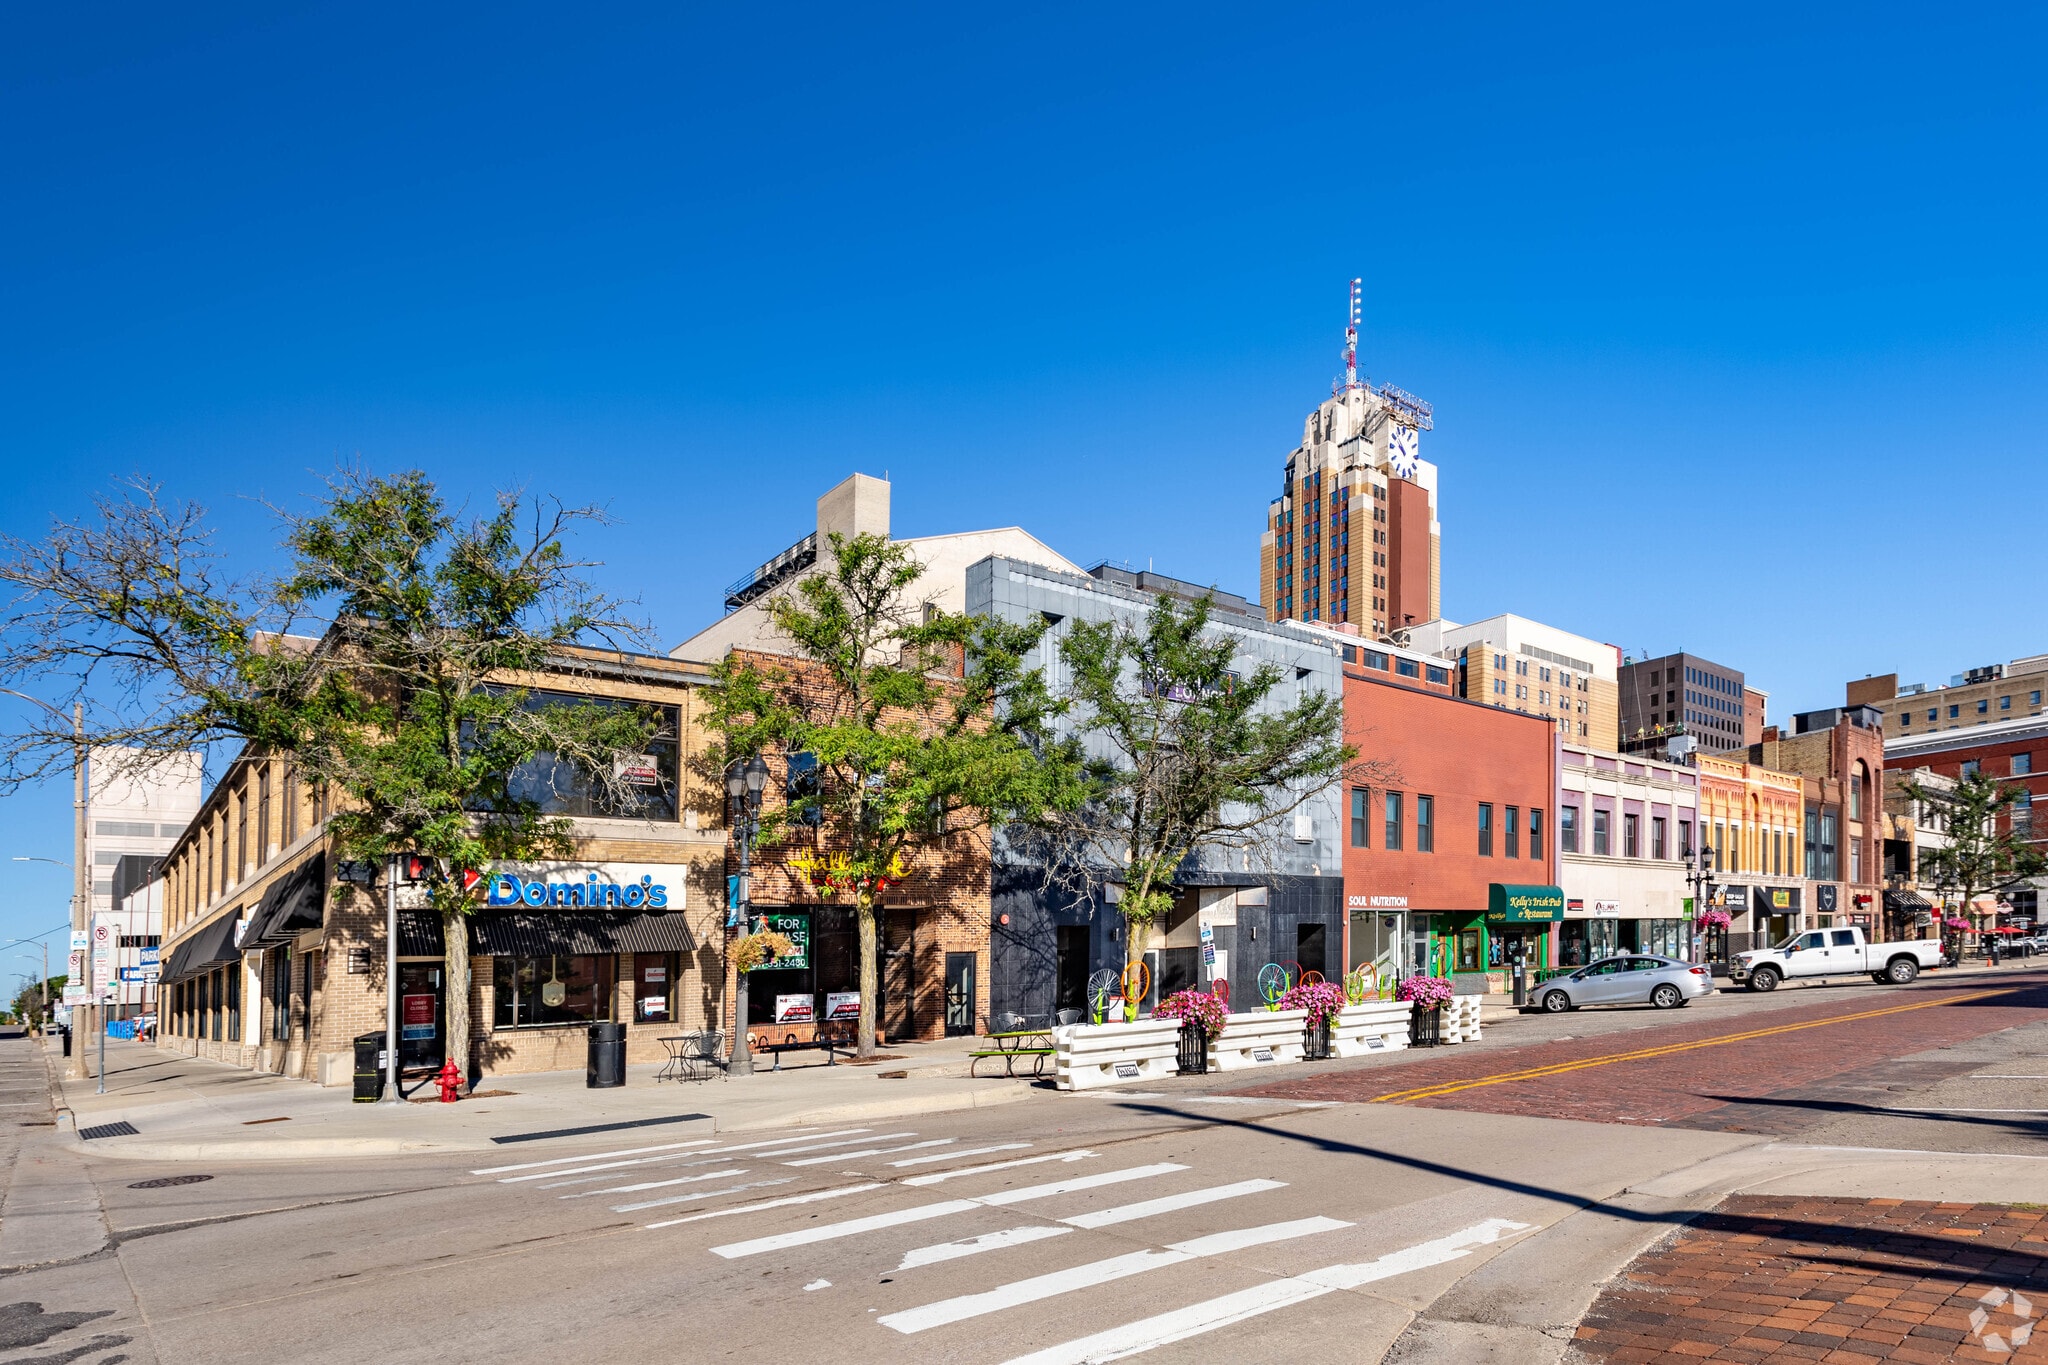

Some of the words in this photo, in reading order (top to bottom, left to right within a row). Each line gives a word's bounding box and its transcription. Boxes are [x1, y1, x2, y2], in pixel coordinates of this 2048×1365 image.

[488, 872, 668, 907] Domino's
[1348, 895, 1367, 906] SOUL
[1370, 896, 1408, 907] NUTRITION
[1510, 896, 1532, 910] Kelly's
[1533, 896, 1549, 906] Irish
[1549, 896, 1562, 907] Pub
[1524, 909, 1553, 920] Restaurant
[778, 919, 800, 929] FOR
